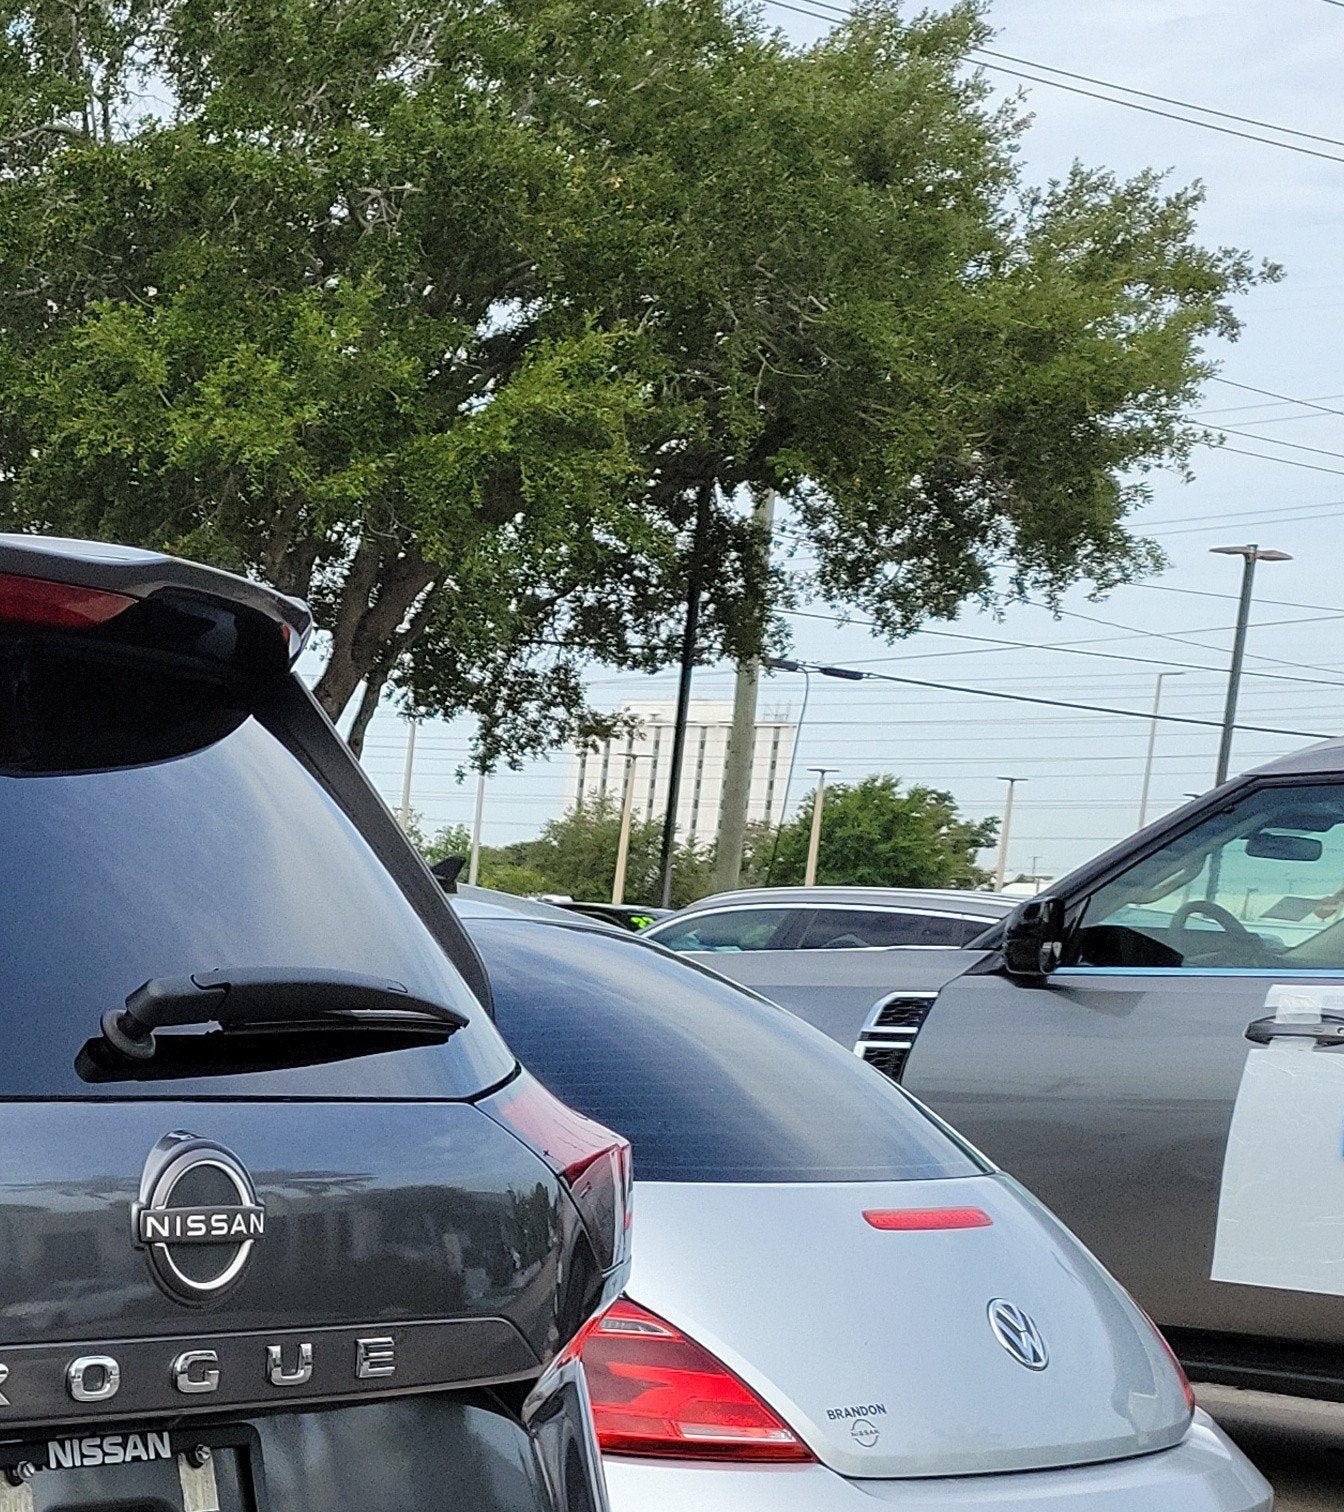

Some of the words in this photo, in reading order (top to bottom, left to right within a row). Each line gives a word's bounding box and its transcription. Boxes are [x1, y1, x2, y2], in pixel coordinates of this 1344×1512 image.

[146, 1212, 264, 1238] NISSAN
[826, 1403, 888, 1420] BRANDON
[48, 1431, 172, 1469] NISSAN
